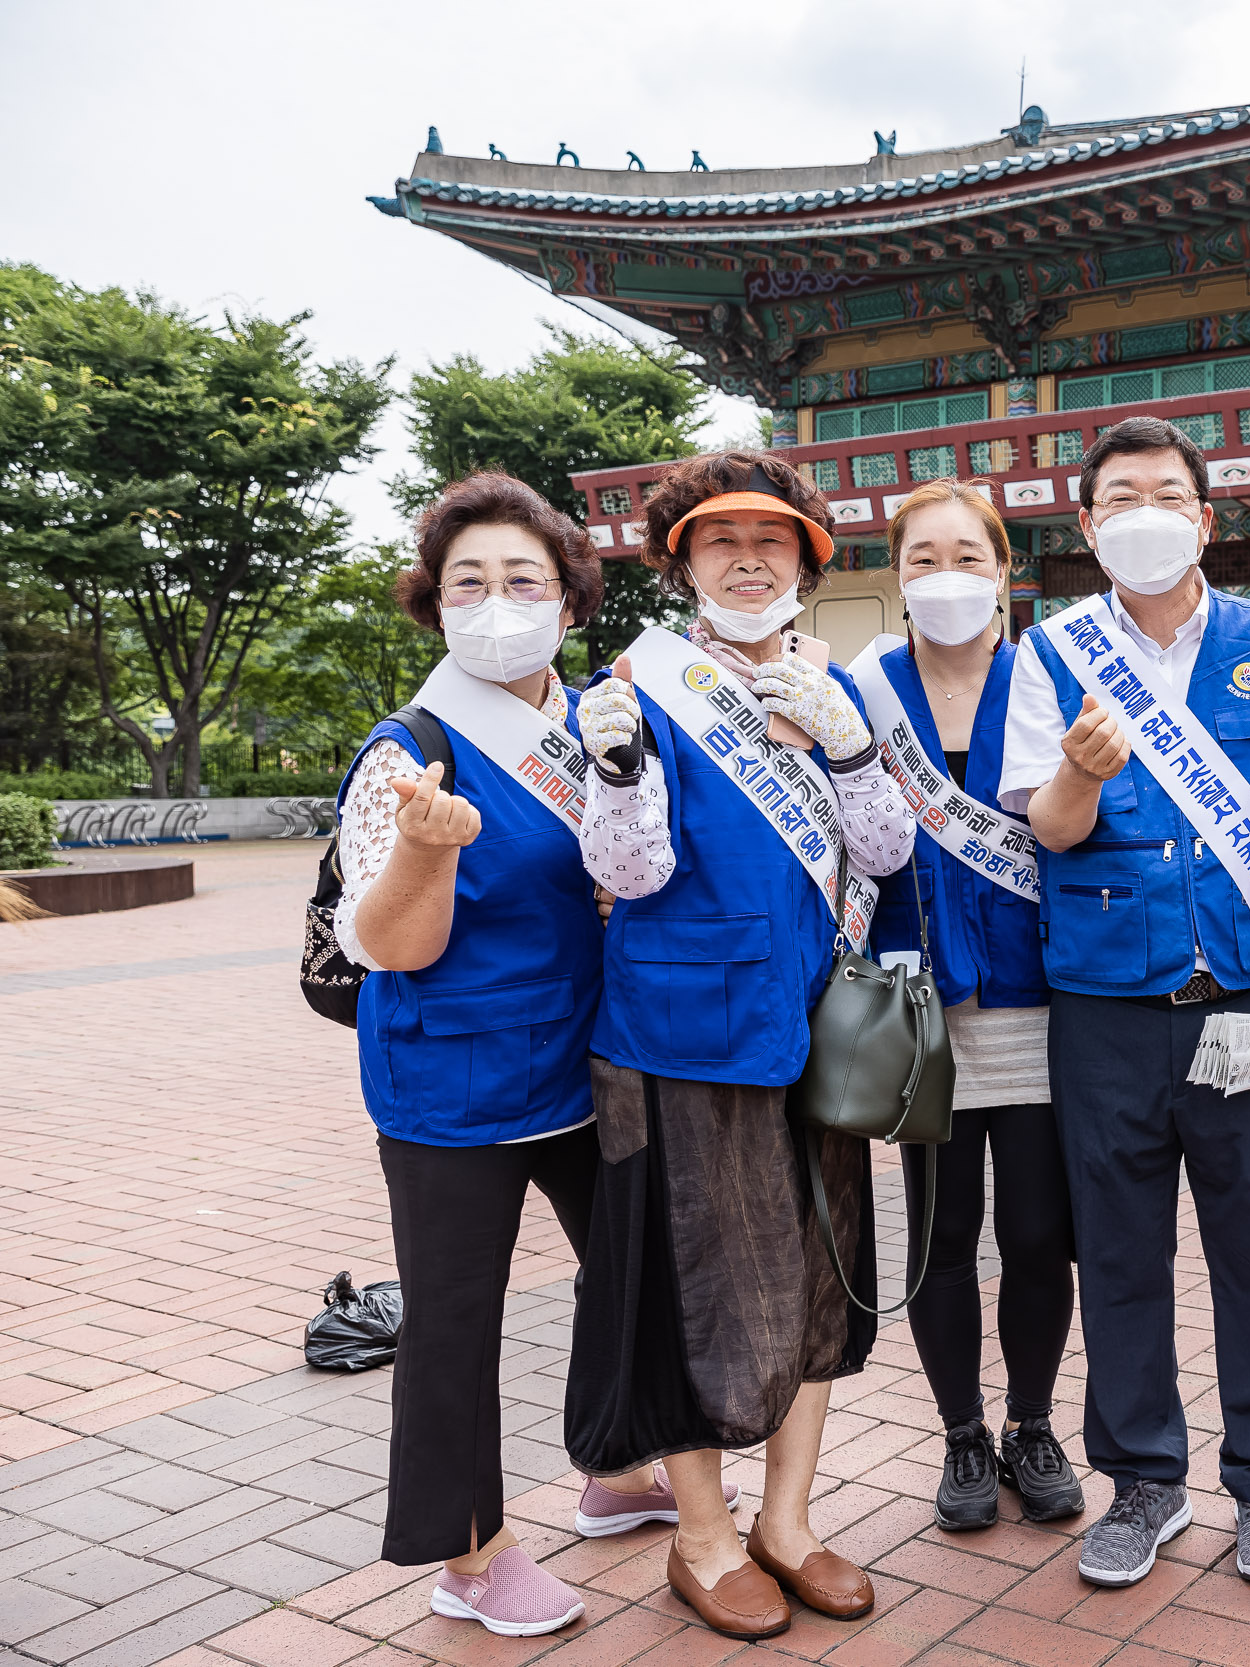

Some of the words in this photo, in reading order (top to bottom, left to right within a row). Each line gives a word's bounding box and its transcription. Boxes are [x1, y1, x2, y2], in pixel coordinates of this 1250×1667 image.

[893, 722, 941, 796] 여름철
[943, 795, 998, 836] 행락
[1064, 614, 1113, 666] 법질서
[1097, 655, 1157, 719] 확립을
[1140, 710, 1186, 757] 위한
[1170, 747, 1242, 826] 기초질서
[705, 723, 827, 862] 마스크착용
